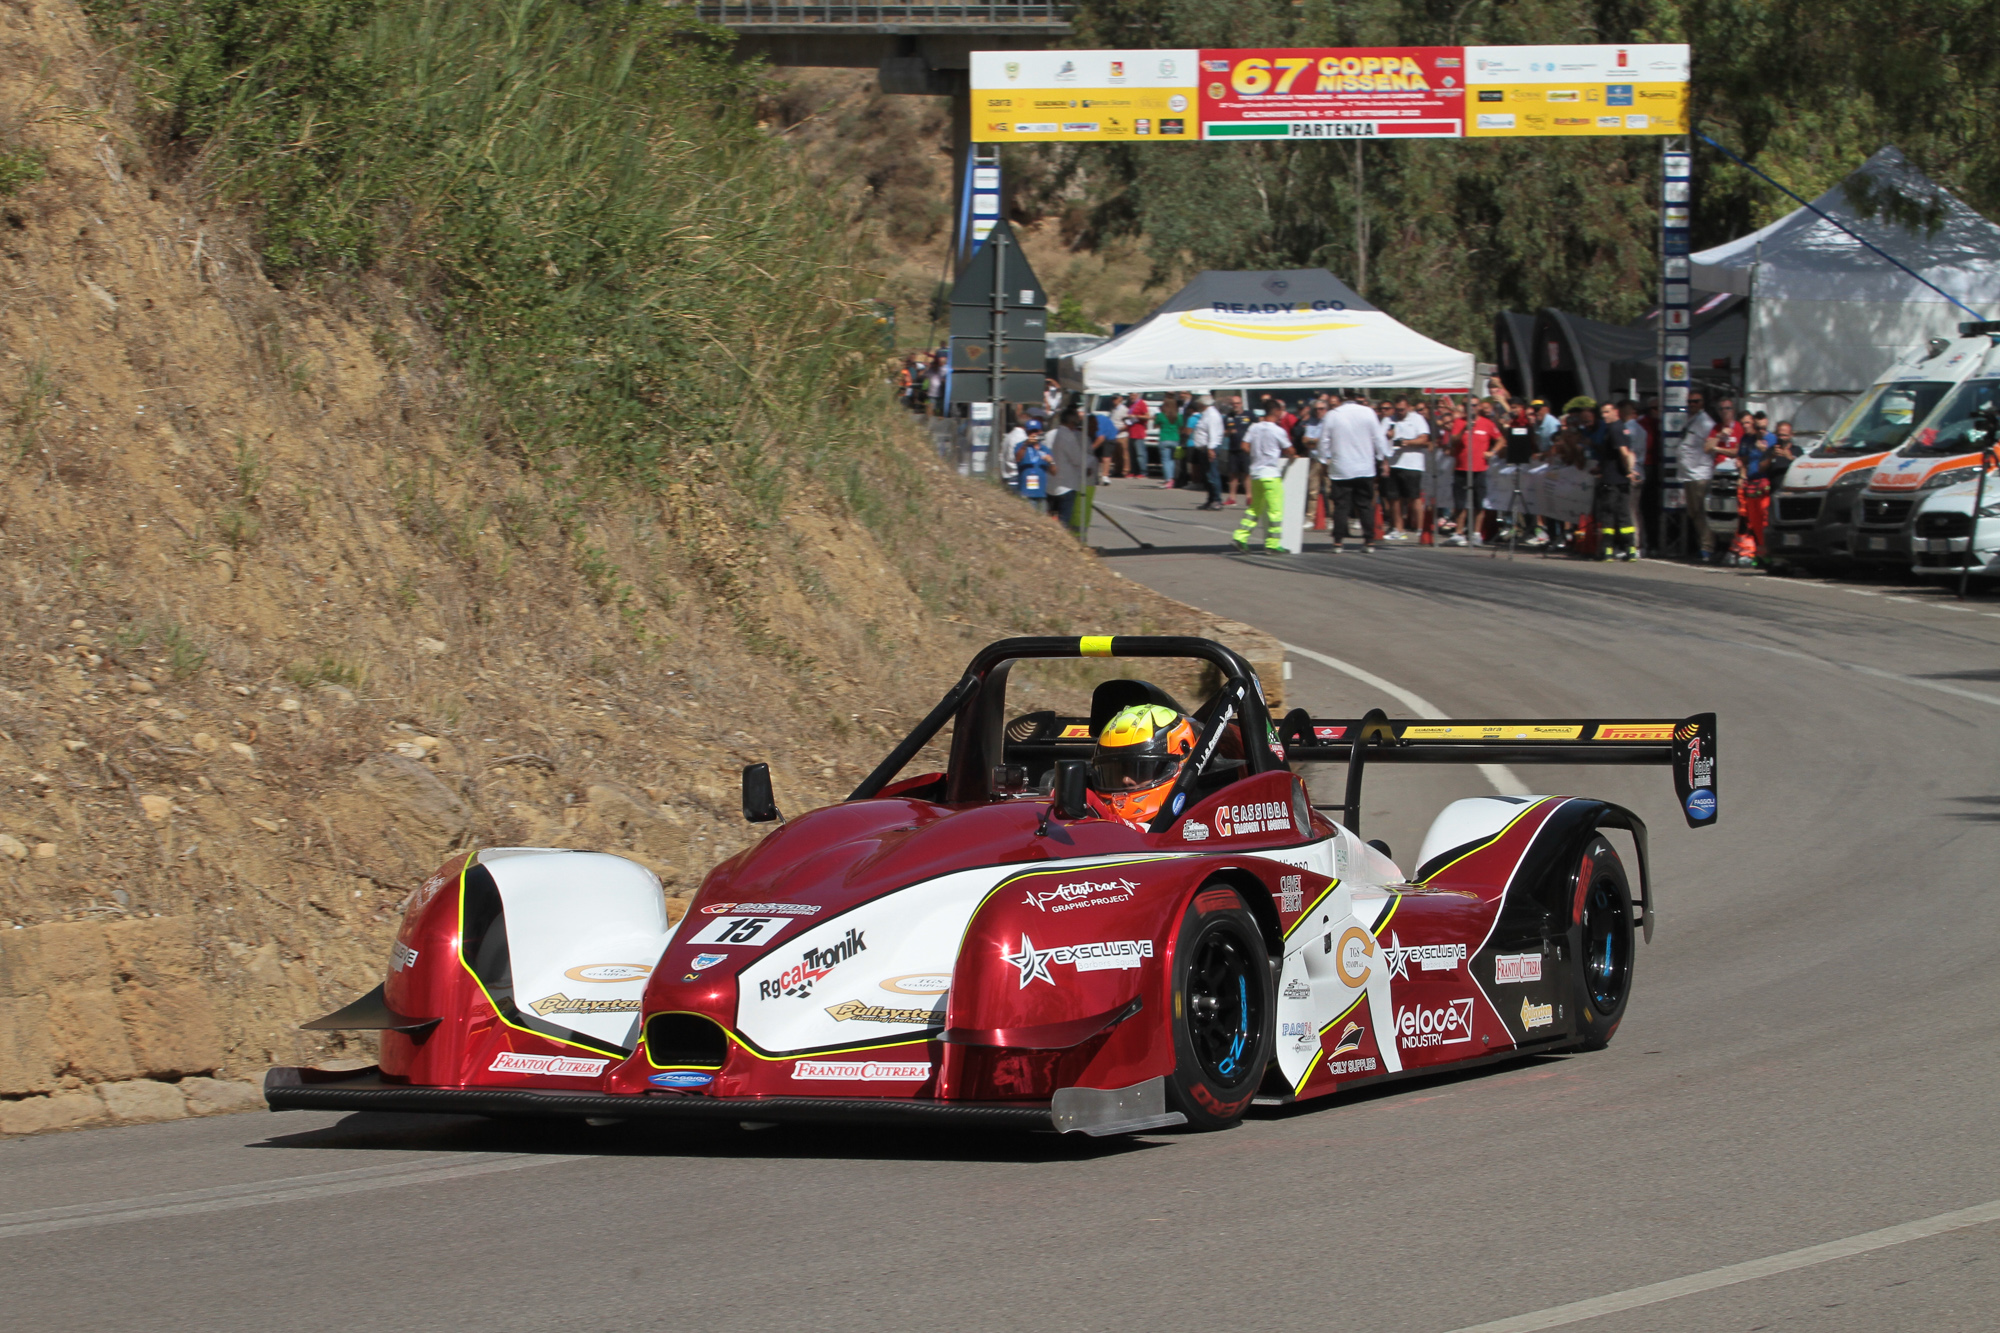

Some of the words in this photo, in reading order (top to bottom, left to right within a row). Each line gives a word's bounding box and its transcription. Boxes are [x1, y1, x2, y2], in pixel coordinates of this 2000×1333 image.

[1317, 57, 1424, 76] COPPA
[1315, 73, 1431, 93] NISSENA
[1293, 123, 1374, 136] PARTENZA
[1165, 362, 1254, 380] Automobile
[1259, 361, 1293, 379] Club
[1297, 361, 1393, 378] Caltanissetta
[1231, 801, 1289, 822] CASSIBBA
[1051, 900, 1091, 913] GRAPHIC
[1091, 894, 1130, 906] PROJECT
[714, 918, 772, 943] 15
[1055, 942, 1152, 962] EXSCLUSIVE
[1411, 946, 1466, 960] EXSCLUSIVE
[1401, 1032, 1443, 1049] INDUSTRY
